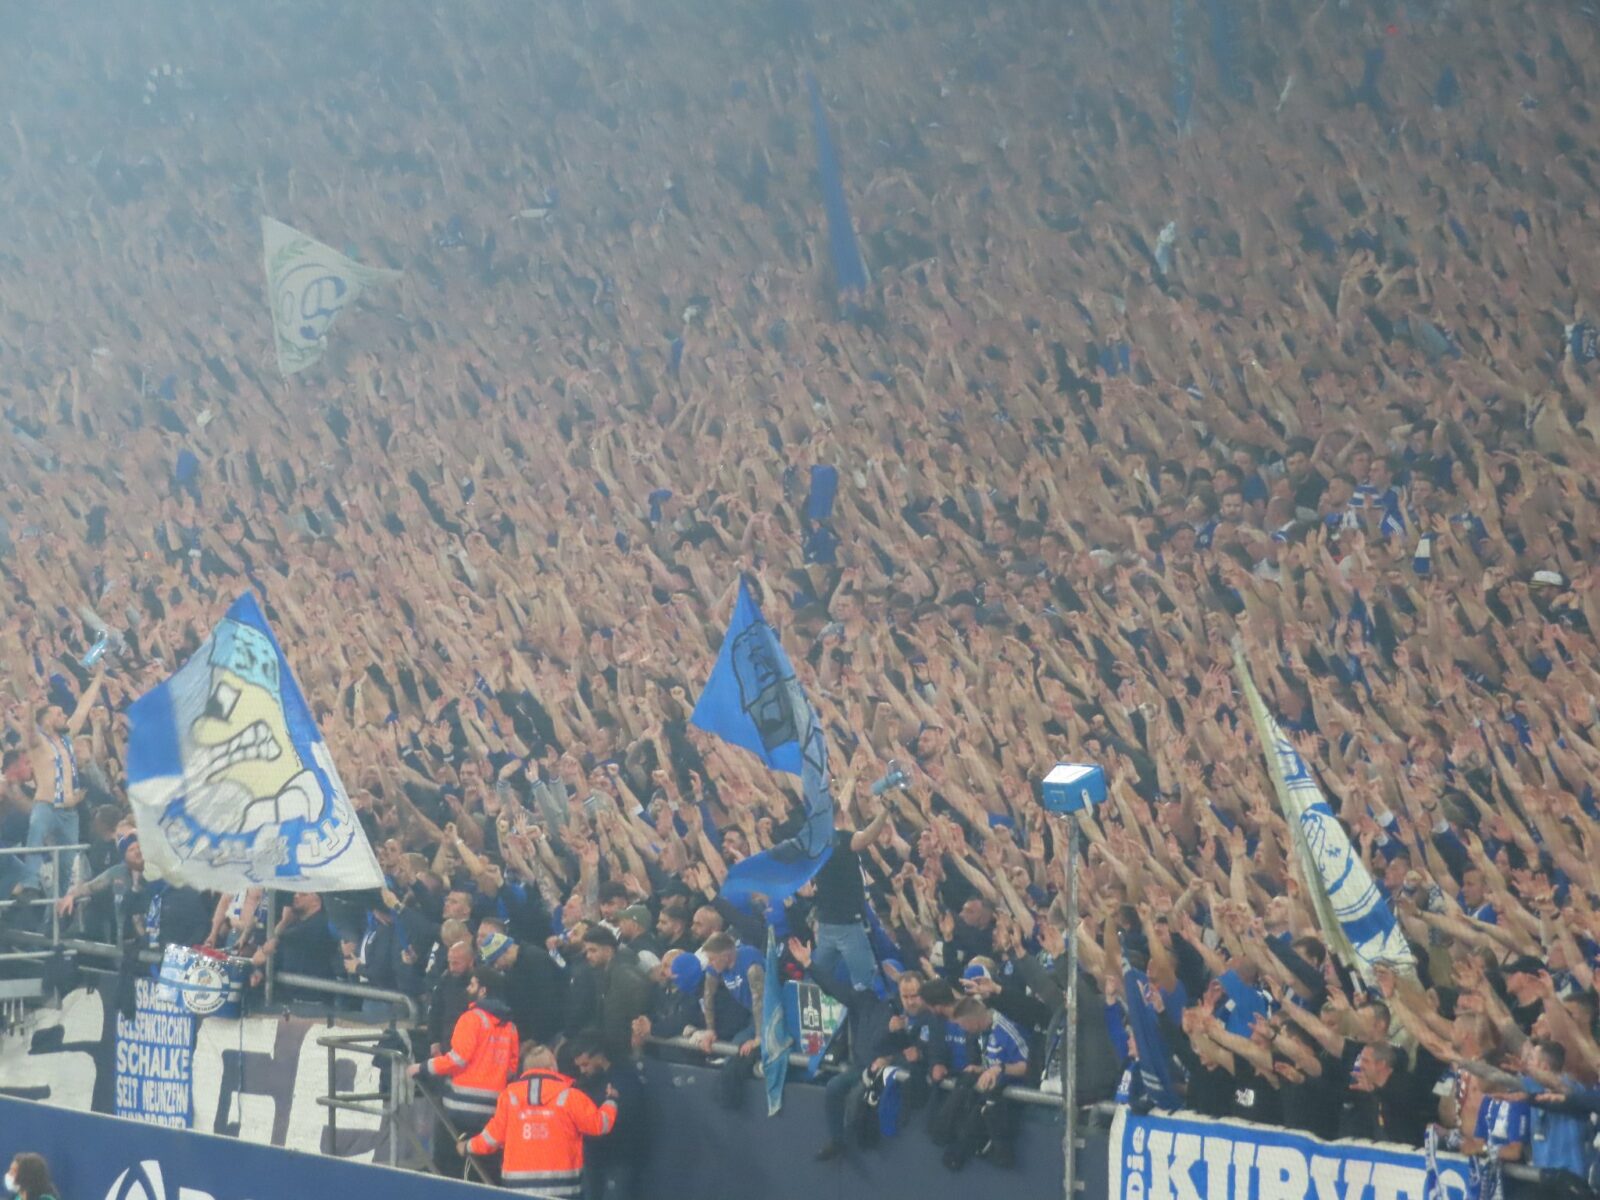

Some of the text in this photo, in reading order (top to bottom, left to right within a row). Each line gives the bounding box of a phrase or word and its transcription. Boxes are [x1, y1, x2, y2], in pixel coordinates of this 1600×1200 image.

[117, 1040, 190, 1080] SCHALKE
[117, 1074, 189, 1114] SEIT NEUNZEHN
